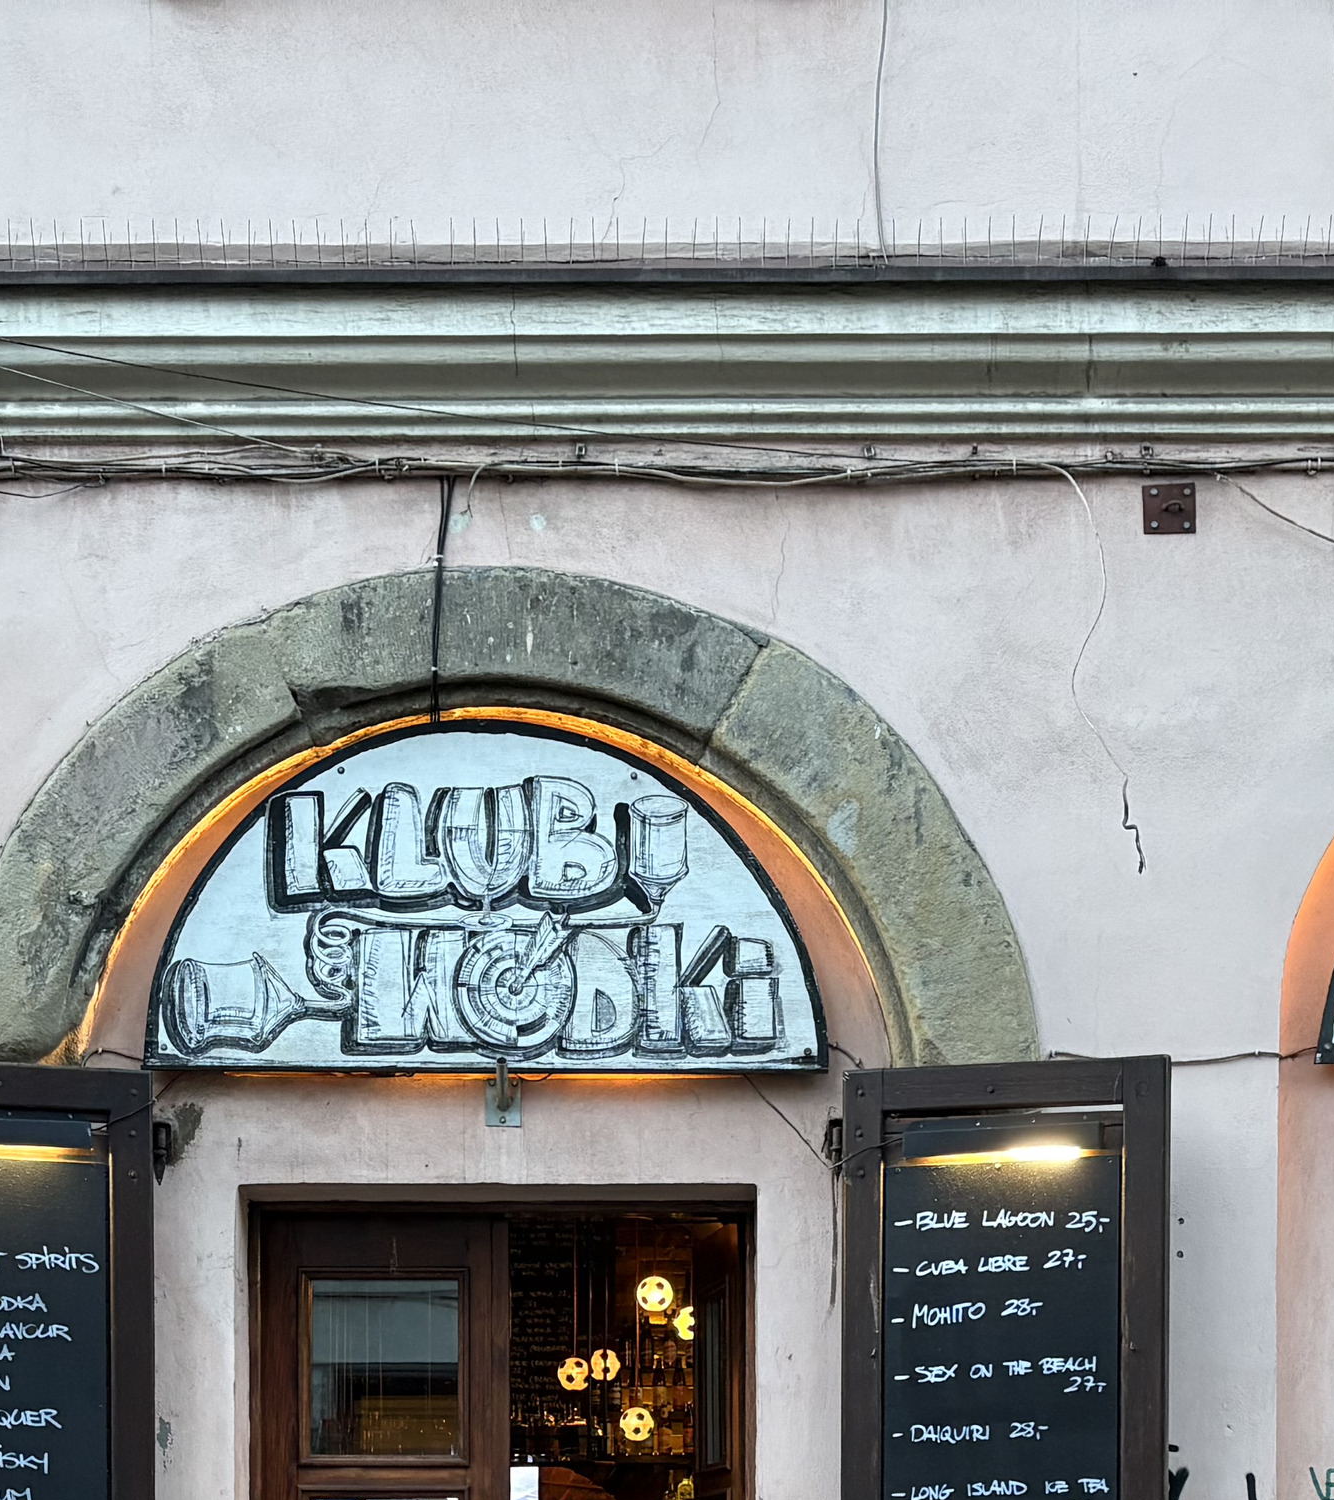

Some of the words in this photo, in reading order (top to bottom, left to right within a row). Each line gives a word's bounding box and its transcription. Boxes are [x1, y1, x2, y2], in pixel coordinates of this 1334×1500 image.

[268, 775, 621, 913] KLUB
[982, 1209, 1054, 1228] LAGOON
[978, 1255, 1030, 1272] LIBRE
[970, 1364, 992, 1379] ON
[1003, 1360, 1033, 1377] THE
[1039, 1356, 1096, 1373] BEACH
[967, 1480, 1028, 1496] ISLAND
[1078, 1478, 1109, 1494] TEA
